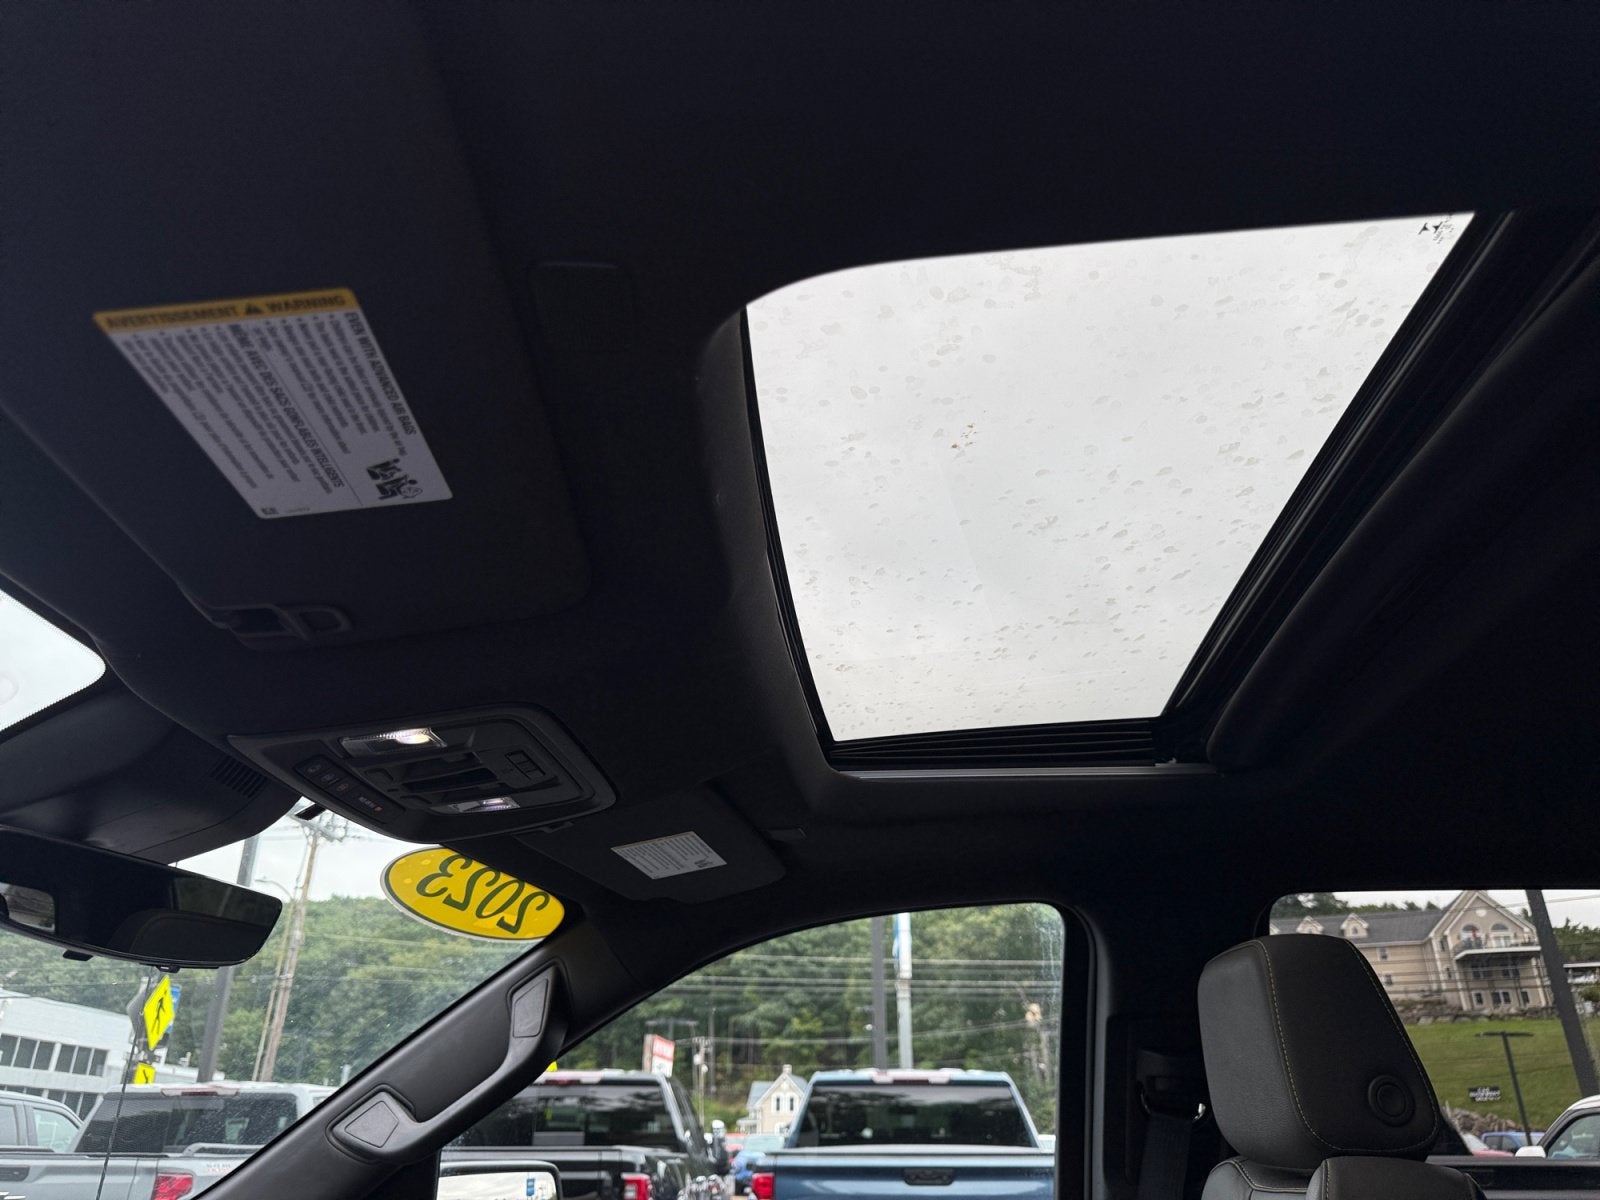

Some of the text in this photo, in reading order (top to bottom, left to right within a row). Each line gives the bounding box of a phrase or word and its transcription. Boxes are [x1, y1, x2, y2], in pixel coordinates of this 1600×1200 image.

[106, 296, 346, 328] AVERTISSEMENT WARNING
[244, 350, 270, 371] AVEC
[258, 371, 280, 386] DES
[269, 387, 293, 406] SACS
[344, 312, 417, 435] EVEN WITH ADVANCED AIR BAGS
